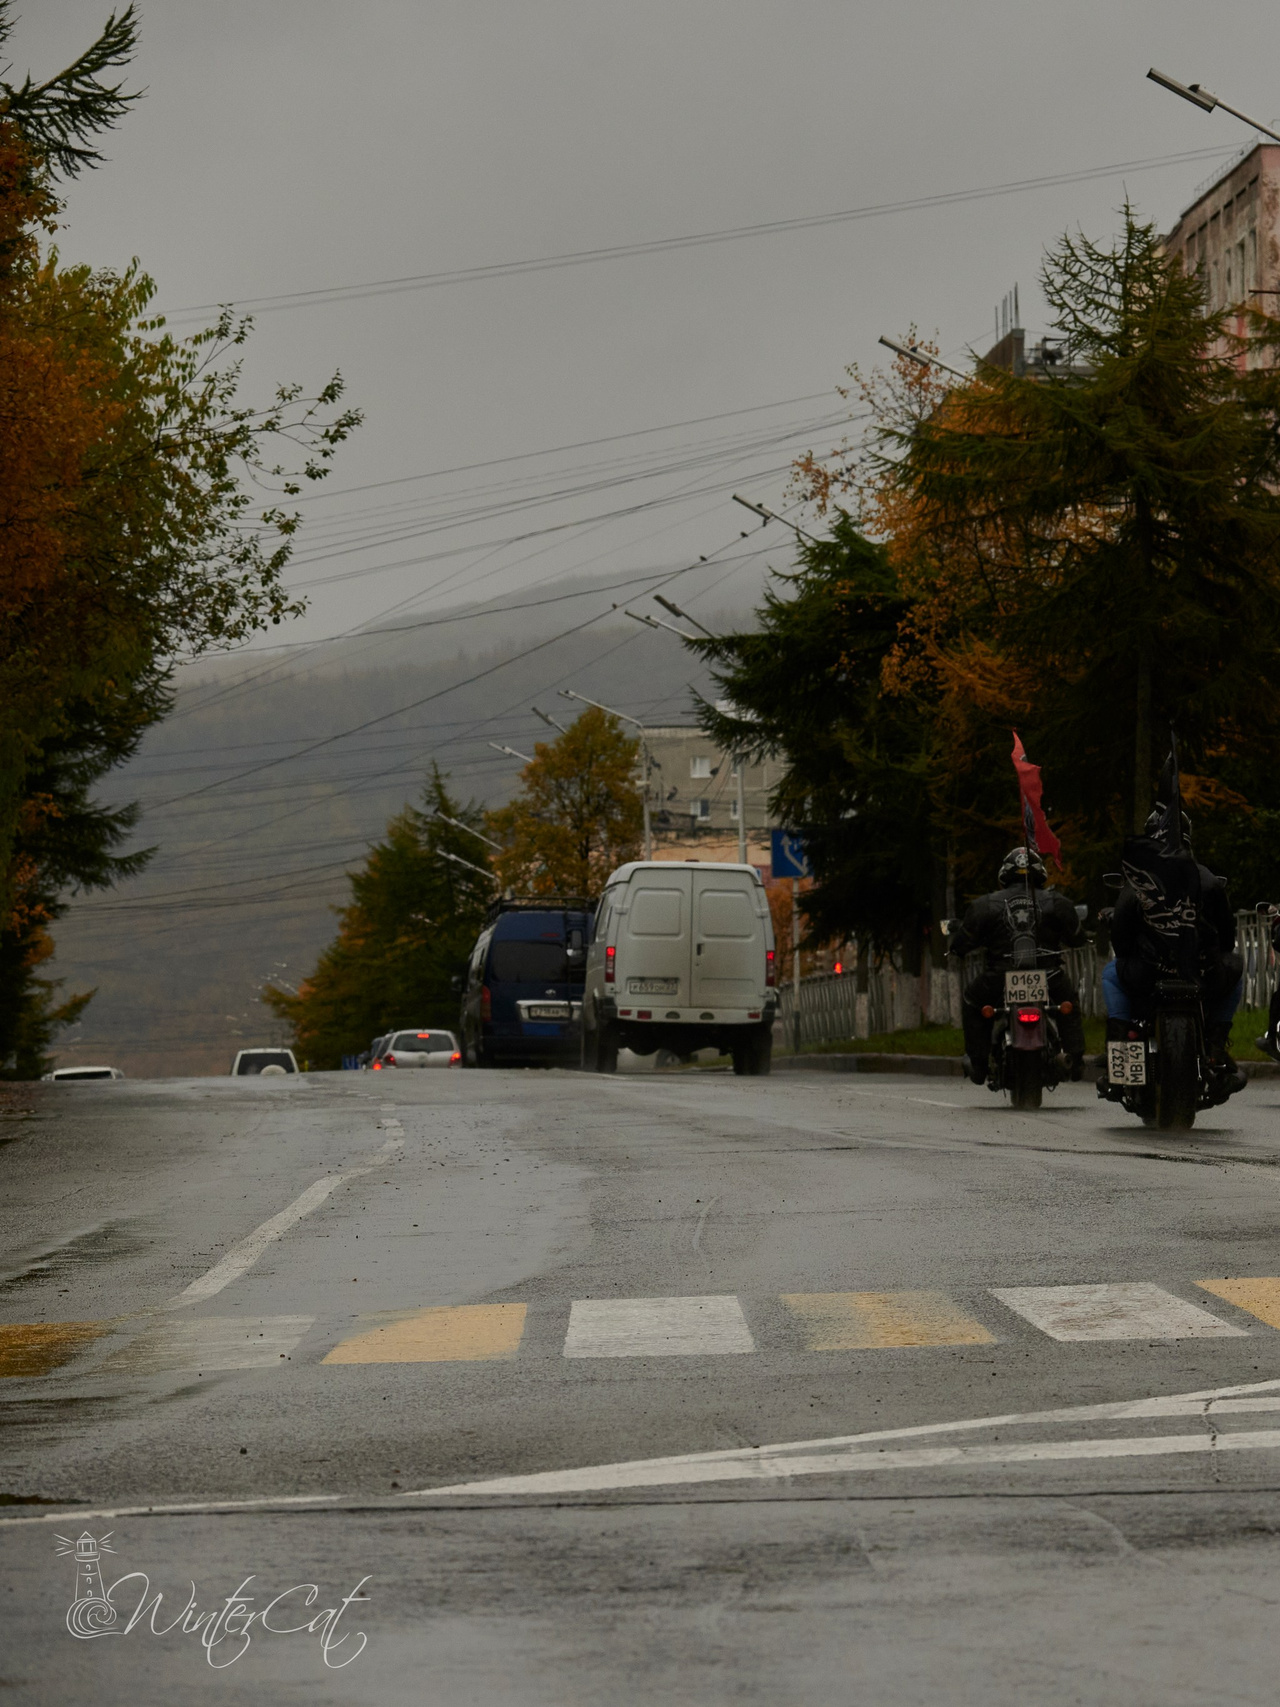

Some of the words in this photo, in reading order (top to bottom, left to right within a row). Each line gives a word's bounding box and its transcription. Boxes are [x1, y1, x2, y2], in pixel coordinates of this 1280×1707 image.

[1011, 973, 1041, 986] 0169
[1008, 989, 1026, 1001] MB
[1030, 988, 1045, 1000] 49
[1129, 1045, 1143, 1060] 49
[1111, 1047, 1125, 1078] 0337
[1130, 1064, 1144, 1083] MB
